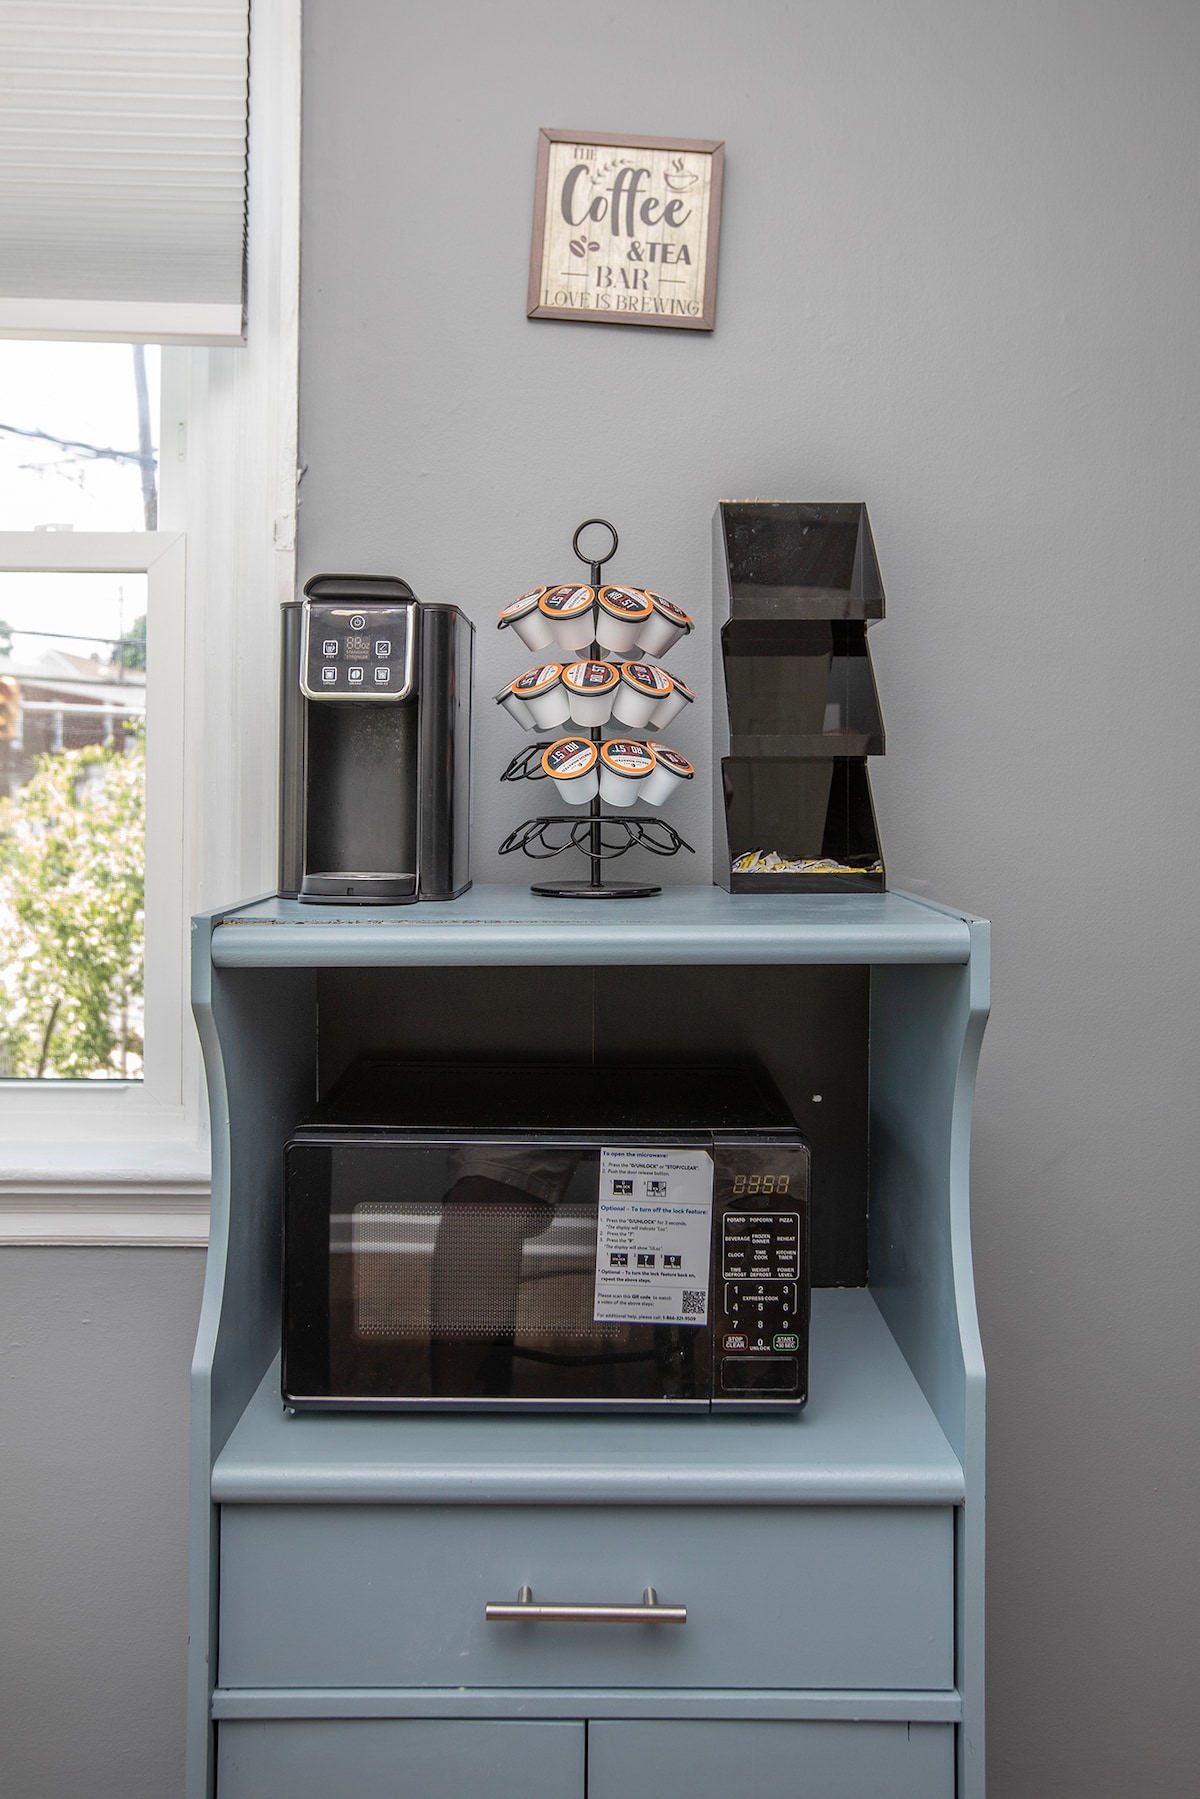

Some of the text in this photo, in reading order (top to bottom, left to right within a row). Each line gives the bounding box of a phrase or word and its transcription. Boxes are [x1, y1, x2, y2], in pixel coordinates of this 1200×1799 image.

[572, 148, 597, 161] THE
[561, 164, 692, 237] Coffee
[596, 266, 649, 290] BAR
[544, 290, 699, 315] LOVE IS BREWING
[734, 1286, 738, 1294] 1
[758, 1286, 764, 1294] 2
[783, 1286, 789, 1294] 3
[733, 1303, 738, 1311] 4
[758, 1303, 763, 1311] 5
[783, 1303, 788, 1311] 6
[783, 1321, 788, 1329] 9
